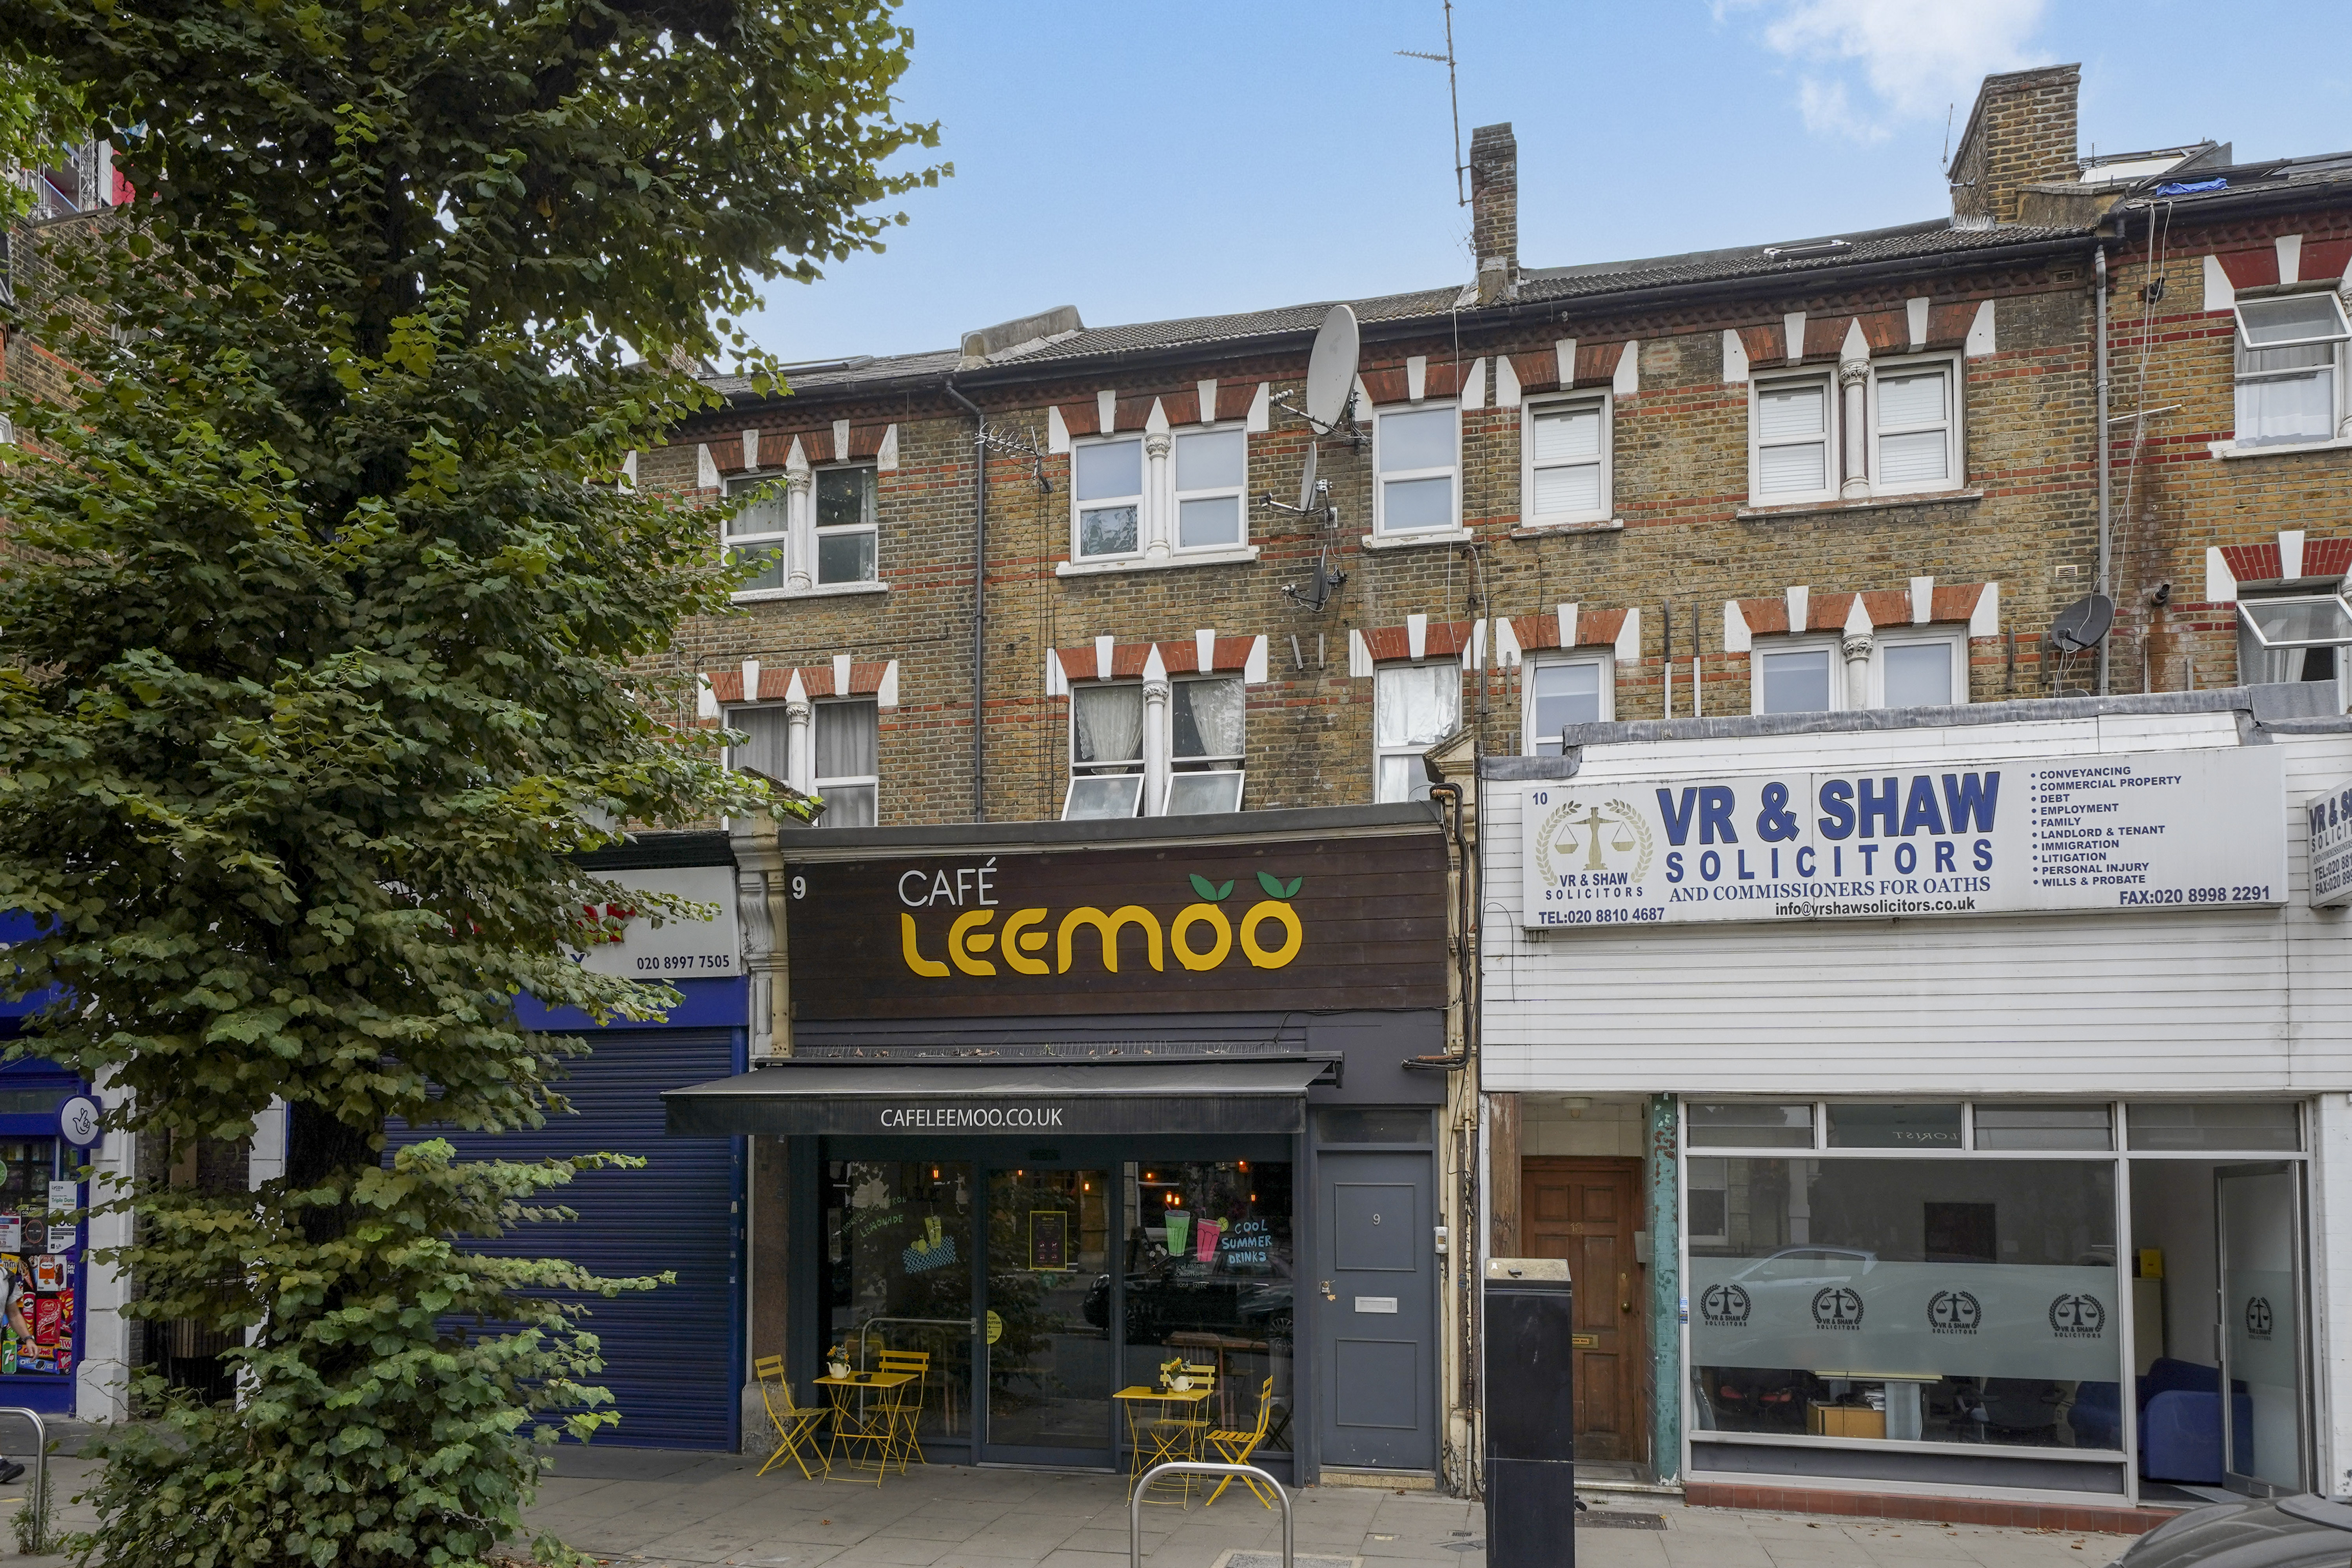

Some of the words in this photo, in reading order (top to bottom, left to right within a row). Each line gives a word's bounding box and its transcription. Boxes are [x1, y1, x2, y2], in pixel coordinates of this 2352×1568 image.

[2040, 767, 2131, 779] CONVEYANCING
[2040, 780, 2116, 791] COMMERCIAL
[2120, 776, 2181, 787] PROPERTY
[1533, 792, 1547, 805] 10
[2041, 794, 2070, 803] DEBT
[1656, 786, 1739, 846] VR
[1757, 782, 1800, 842] &
[1818, 771, 2000, 840] SHAW
[2041, 804, 2118, 815] EMPLOYMENT
[2042, 817, 2081, 827] FAMILY
[2309, 804, 2325, 836] VR
[2329, 797, 2338, 828] &
[2042, 829, 2102, 839] LANDLORD
[2118, 826, 2165, 835] TENANT
[2042, 840, 2119, 851] IMMIGRATION
[1666, 839, 1993, 883] SOLICITORS
[2042, 853, 2106, 862] LITIGATION
[2042, 865, 2102, 875] PERSONAL
[2107, 863, 2149, 872] INJURY
[2314, 859, 2339, 881] TEL:020
[898, 857, 998, 907] CAFÉ
[1560, 875, 1576, 887] VR
[1581, 874, 1588, 886] &
[1593, 873, 1627, 886] SHAW
[2042, 878, 2076, 886] WILLS
[2093, 875, 2145, 884] PROBATE
[2316, 875, 2340, 896] FAX:020
[793, 876, 806, 899] 9
[1546, 887, 1642, 900] SOLICITORS
[1669, 887, 1708, 902] AND
[1713, 881, 1875, 901] COMMISSIONERS
[1879, 880, 1918, 895] FOR
[1923, 877, 1990, 894] OATHS
[2120, 889, 2183, 904] FAX:020
[2189, 887, 2226, 902] 8998
[2232, 886, 2269, 900] 2291
[1775, 897, 1975, 916] info@vrshawsolicitors.co.uk
[1539, 910, 1591, 924] TEL:020
[1596, 909, 1628, 922] 8810
[1633, 907, 1664, 920] 4687
[637, 957, 659, 969] 020
[664, 956, 693, 969] 8997
[699, 955, 729, 967] 7505
[881, 1109, 1062, 1126] CAFELEEMOO.CO.UK
[859, 1214, 903, 1238] LEMONADE
[1235, 1219, 1268, 1234] COOL
[1372, 1214, 1381, 1225] 9
[1570, 1222, 1583, 1234] 10
[1221, 1235, 1272, 1249] SUMMER
[1229, 1251, 1267, 1264] DRINKS
